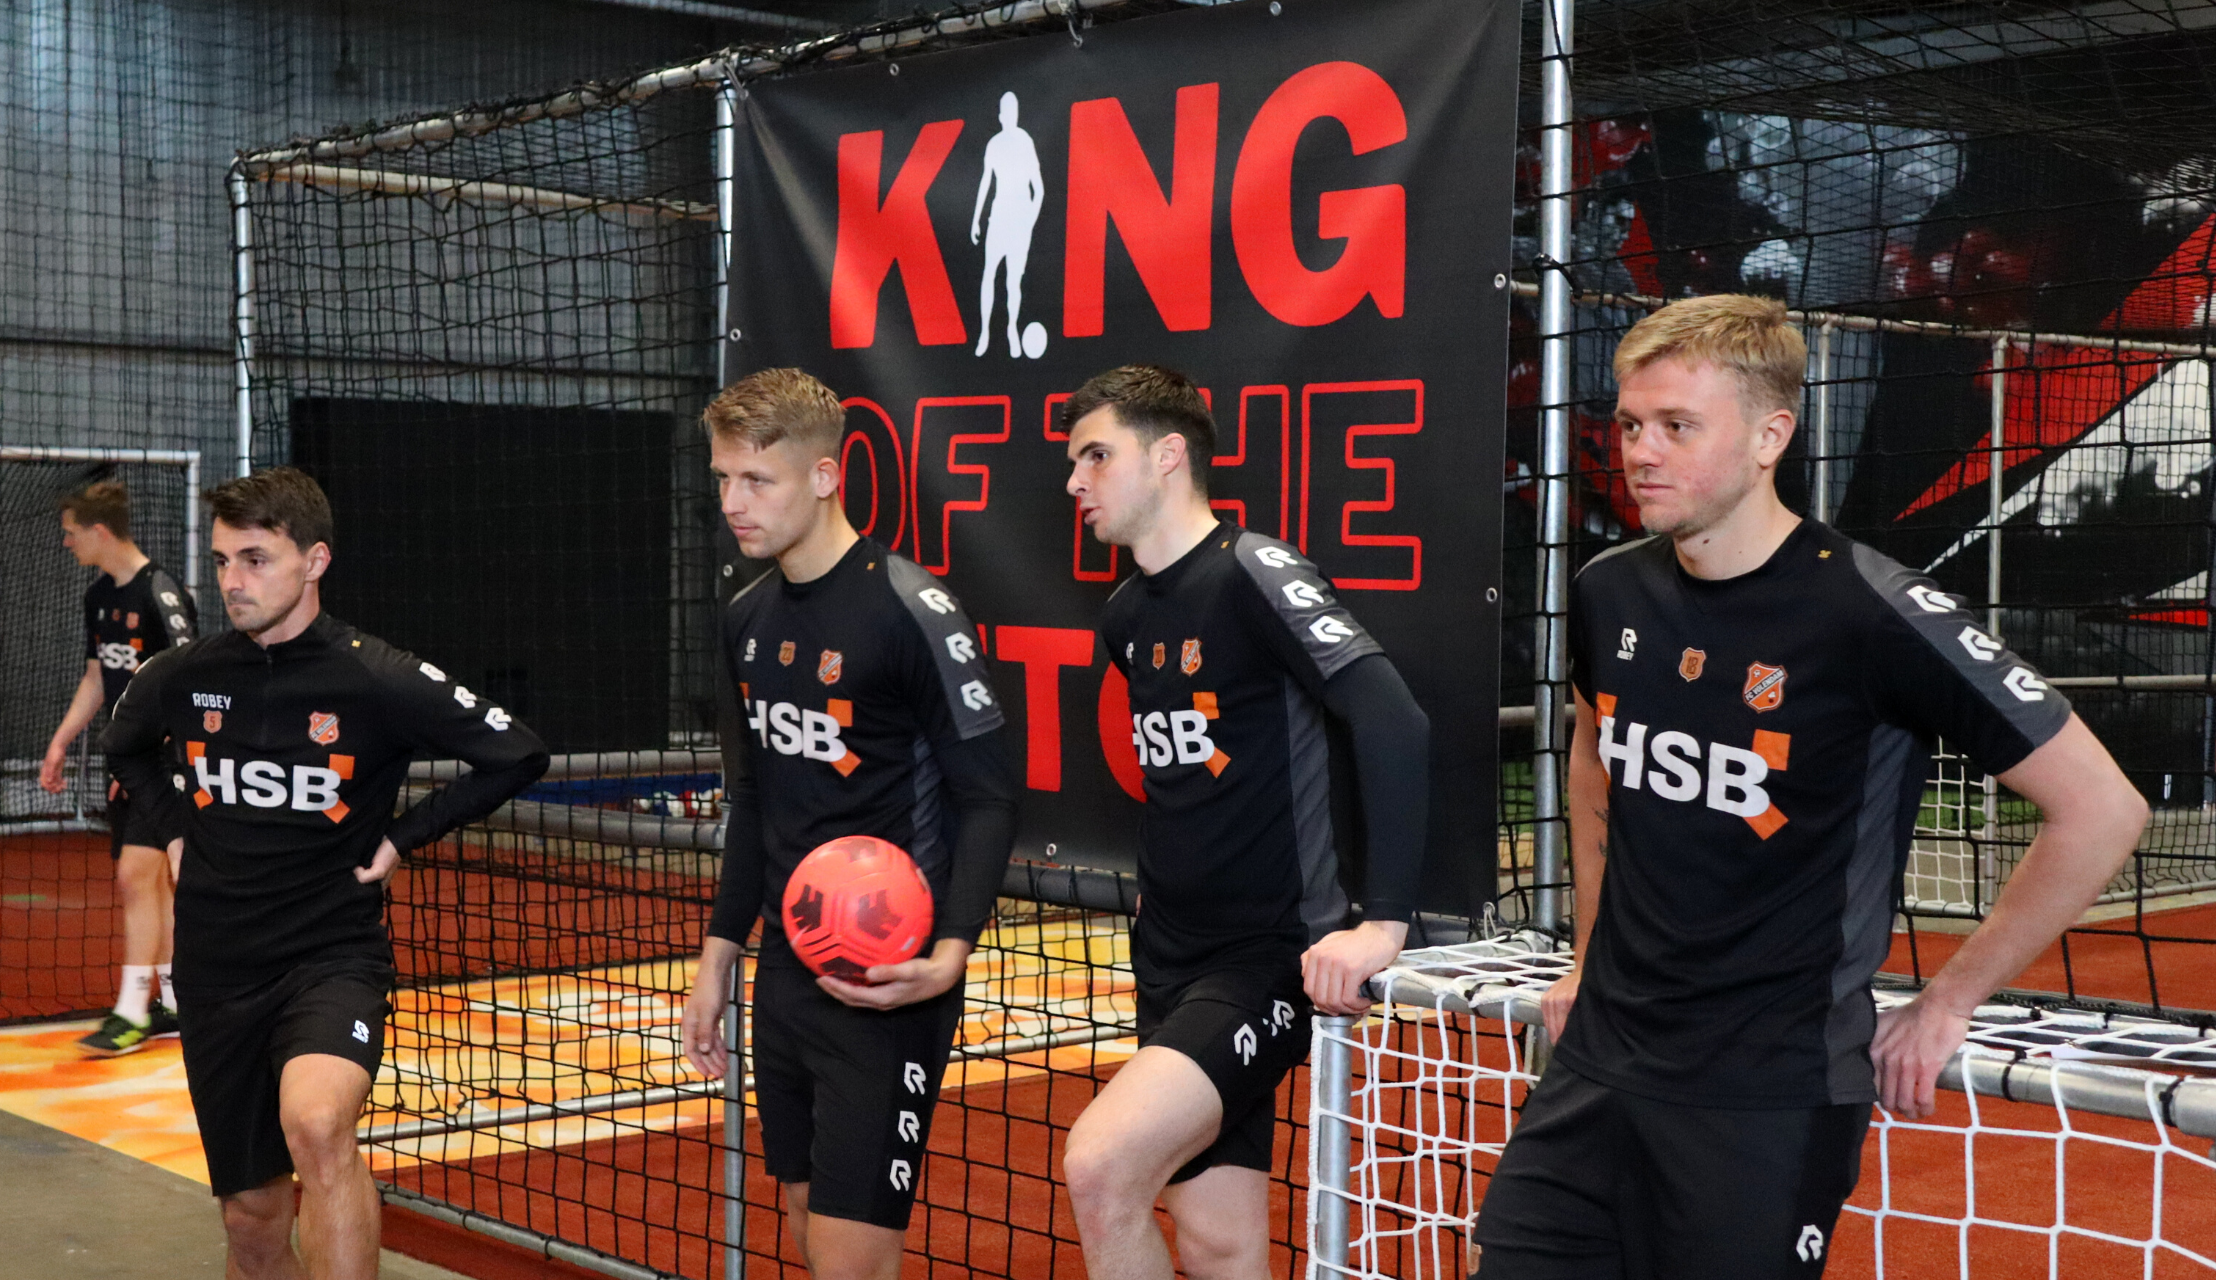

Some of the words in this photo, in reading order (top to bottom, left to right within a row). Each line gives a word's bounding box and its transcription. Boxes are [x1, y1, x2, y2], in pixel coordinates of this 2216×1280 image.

[192, 692, 232, 710] ROBEY
[744, 698, 847, 763] HSB
[194, 756, 341, 811] HSB
[1598, 715, 1771, 818] HSB
